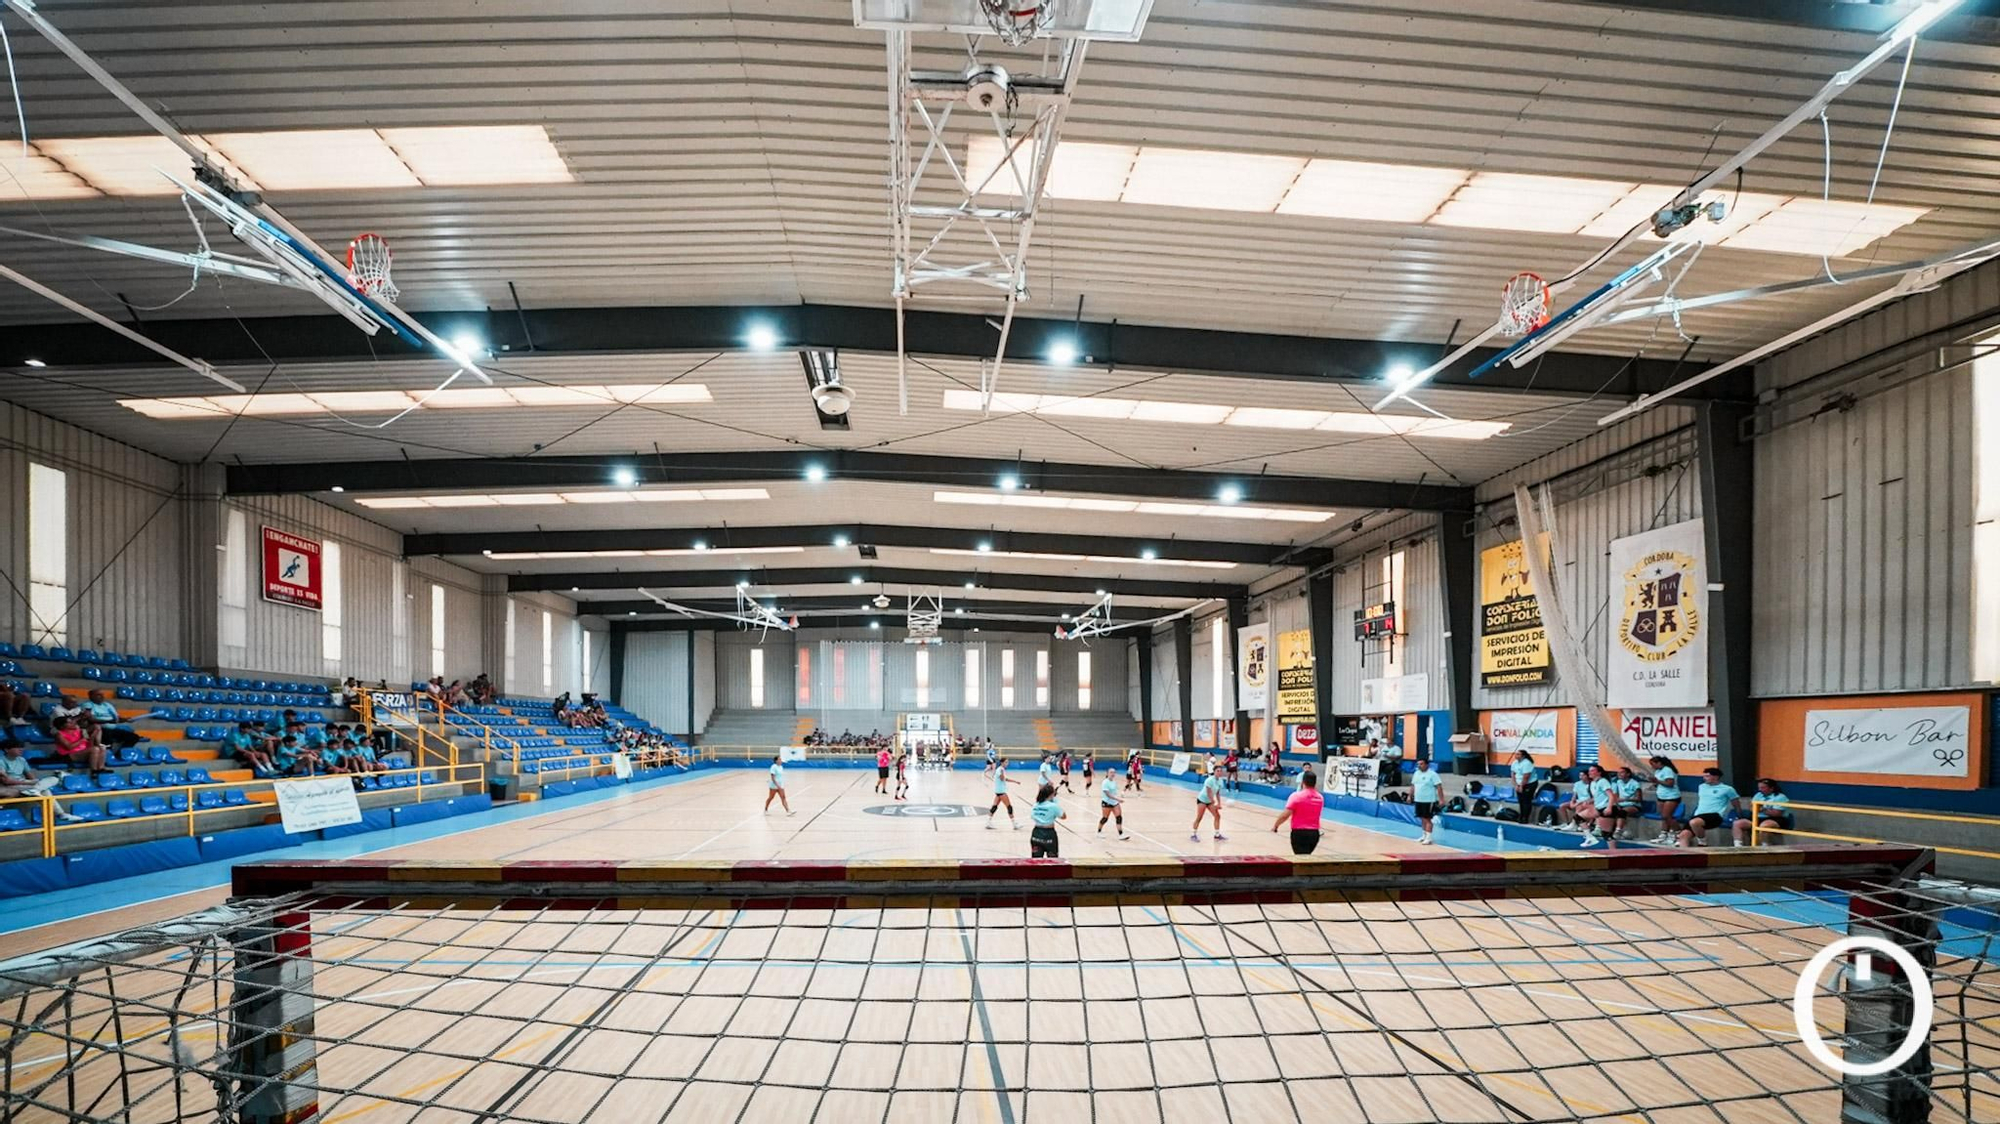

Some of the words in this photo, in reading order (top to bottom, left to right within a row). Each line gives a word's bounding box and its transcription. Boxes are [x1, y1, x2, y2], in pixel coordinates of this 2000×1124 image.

[269, 582, 295, 596] DEPORTE
[296, 589, 304, 597] ES
[305, 591, 319, 600] VIDA
[1486, 614, 1508, 627] DON
[1487, 632, 1530, 648] SERVICIOS
[1532, 630, 1545, 640] DE
[1491, 642, 1540, 658] IMPRESIÓN
[1647, 651, 1667, 661] CLUB
[1497, 658, 1533, 669] DIGITAL
[1633, 671, 1645, 681] C.D.
[1648, 670, 1657, 679] LA
[1660, 668, 1681, 679] SALLE
[1494, 728, 1554, 738] CHINALANDIA
[1809, 720, 1898, 747] Silbon
[1905, 719, 1964, 746] Bar
